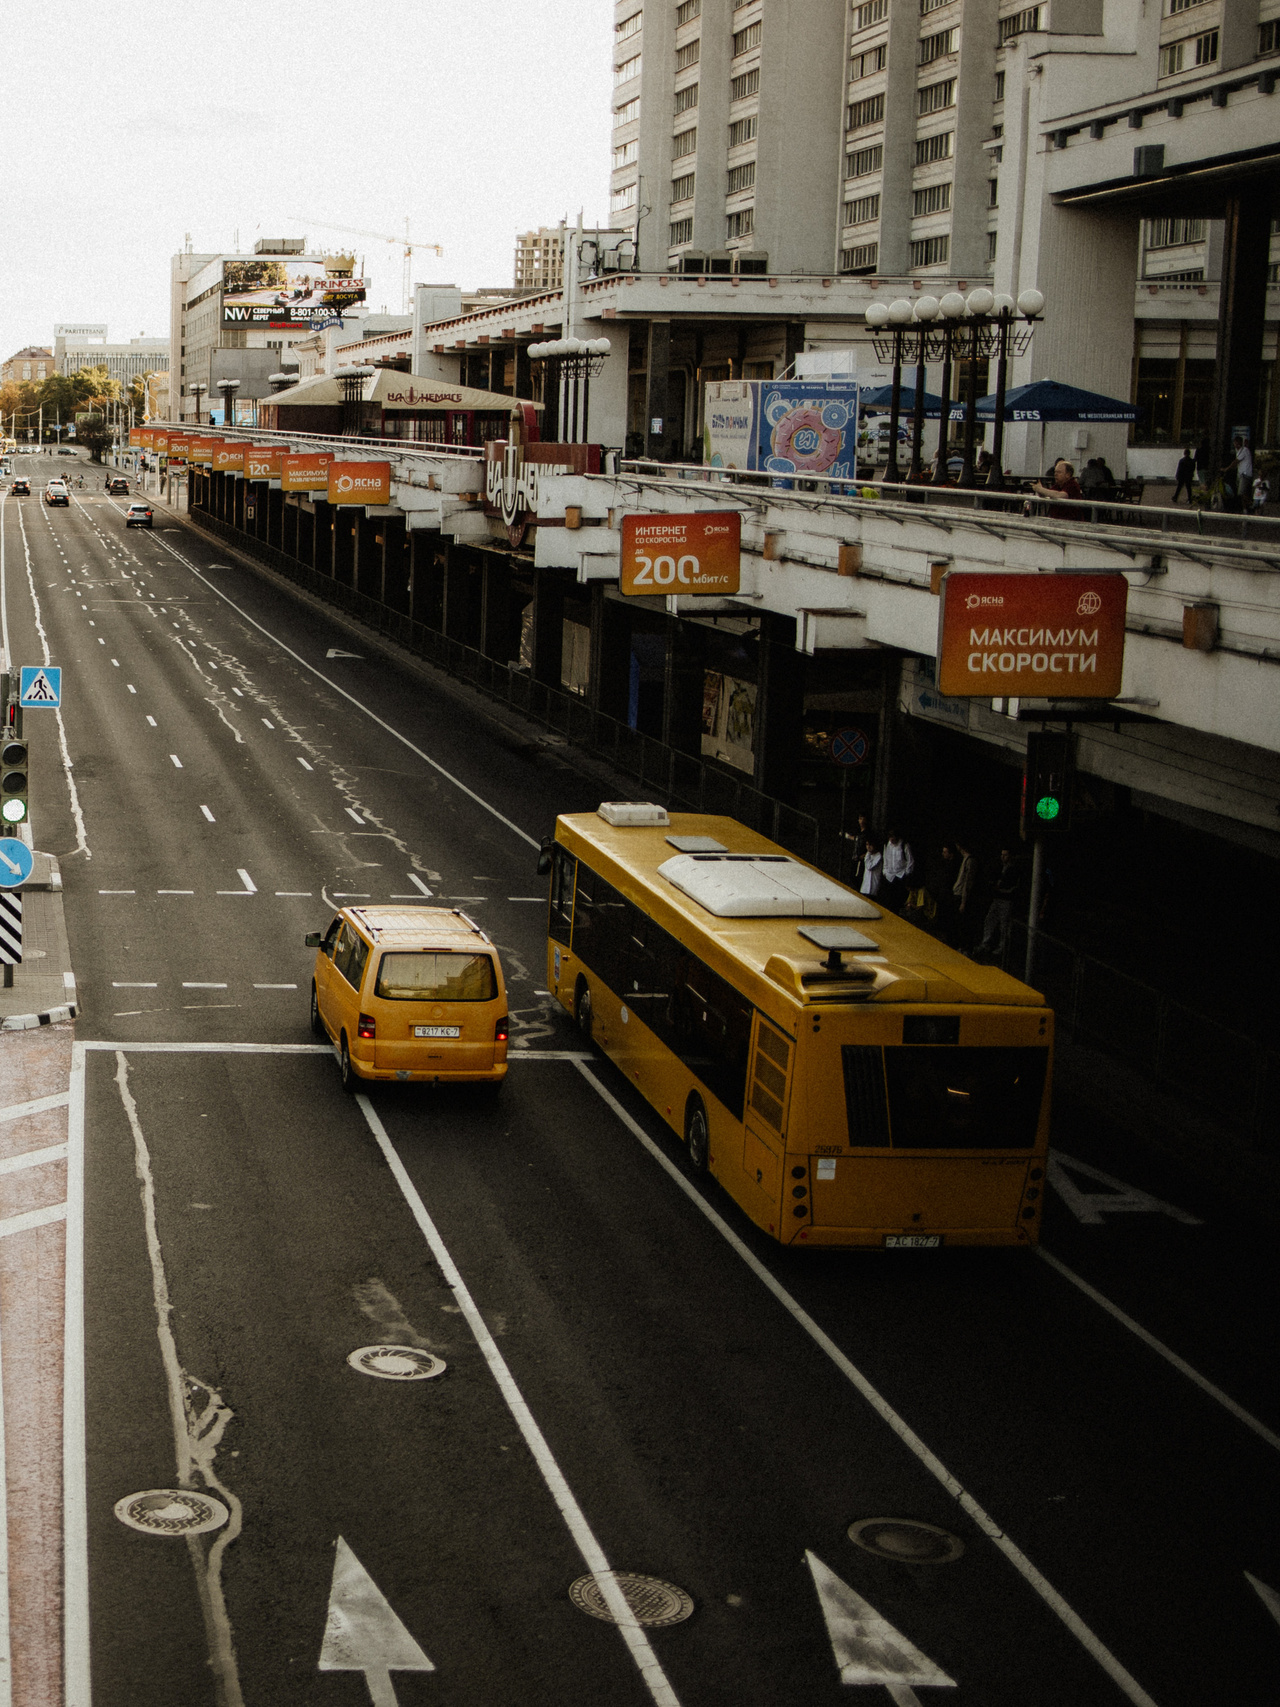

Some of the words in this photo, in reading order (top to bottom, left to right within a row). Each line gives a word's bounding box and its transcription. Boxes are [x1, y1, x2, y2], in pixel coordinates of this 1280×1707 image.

[314, 280, 364, 289] PRINCESS
[225, 307, 252, 321] NW
[387, 392, 405, 402] НА
[419, 393, 463, 403] НЕМИГЕ
[948, 409, 962, 420] EFES
[1012, 410, 1041, 420] EFES
[249, 464, 270, 476] 120
[635, 525, 687, 536] ИНТЕРНЕТ
[645, 536, 687, 544] СКОРОСТЬЮ
[633, 555, 700, 585] 200
[692, 573, 730, 584] мбит/с
[969, 628, 1099, 647] МАКСИМУМ
[967, 652, 1097, 673] СКОРОСТИ
